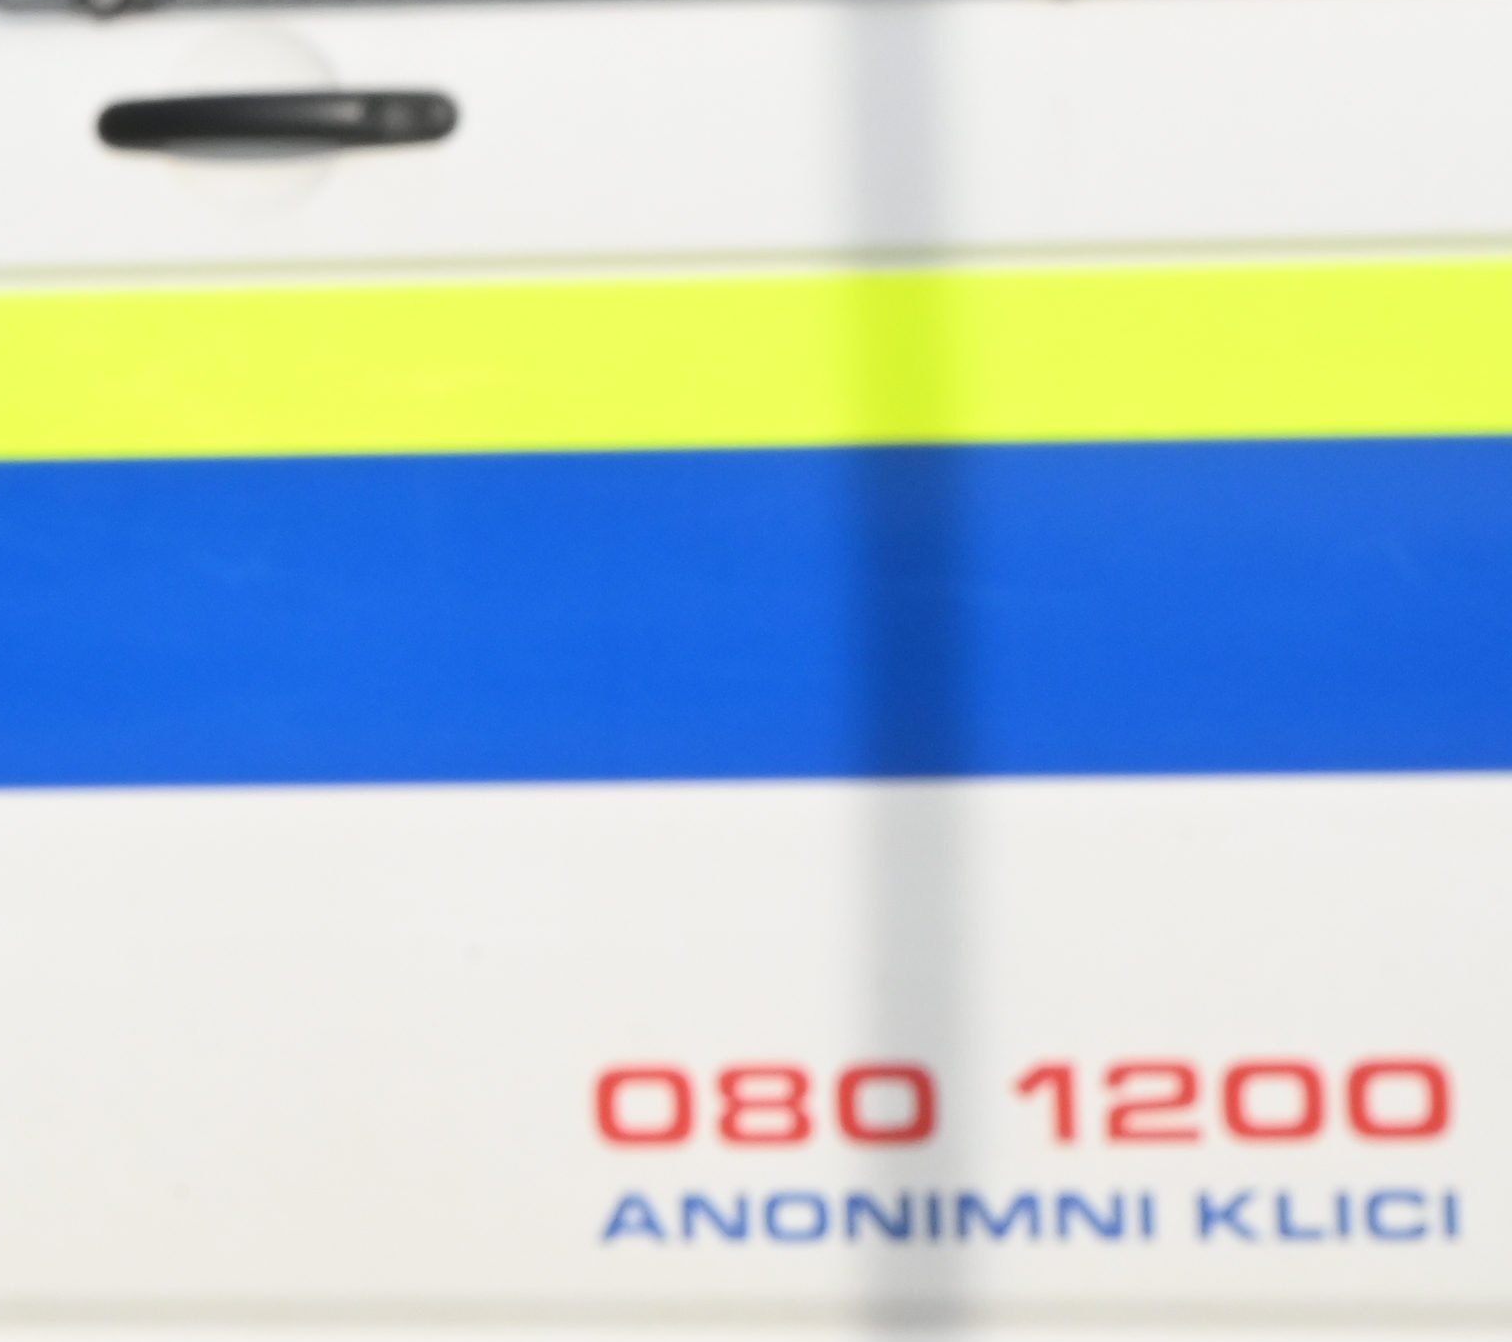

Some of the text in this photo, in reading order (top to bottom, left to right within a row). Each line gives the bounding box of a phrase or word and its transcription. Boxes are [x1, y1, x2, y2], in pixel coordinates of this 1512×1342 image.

[591, 1054, 1455, 1151] 080 1200
[599, 1188, 1462, 1245] ANONIMNI KLICI
